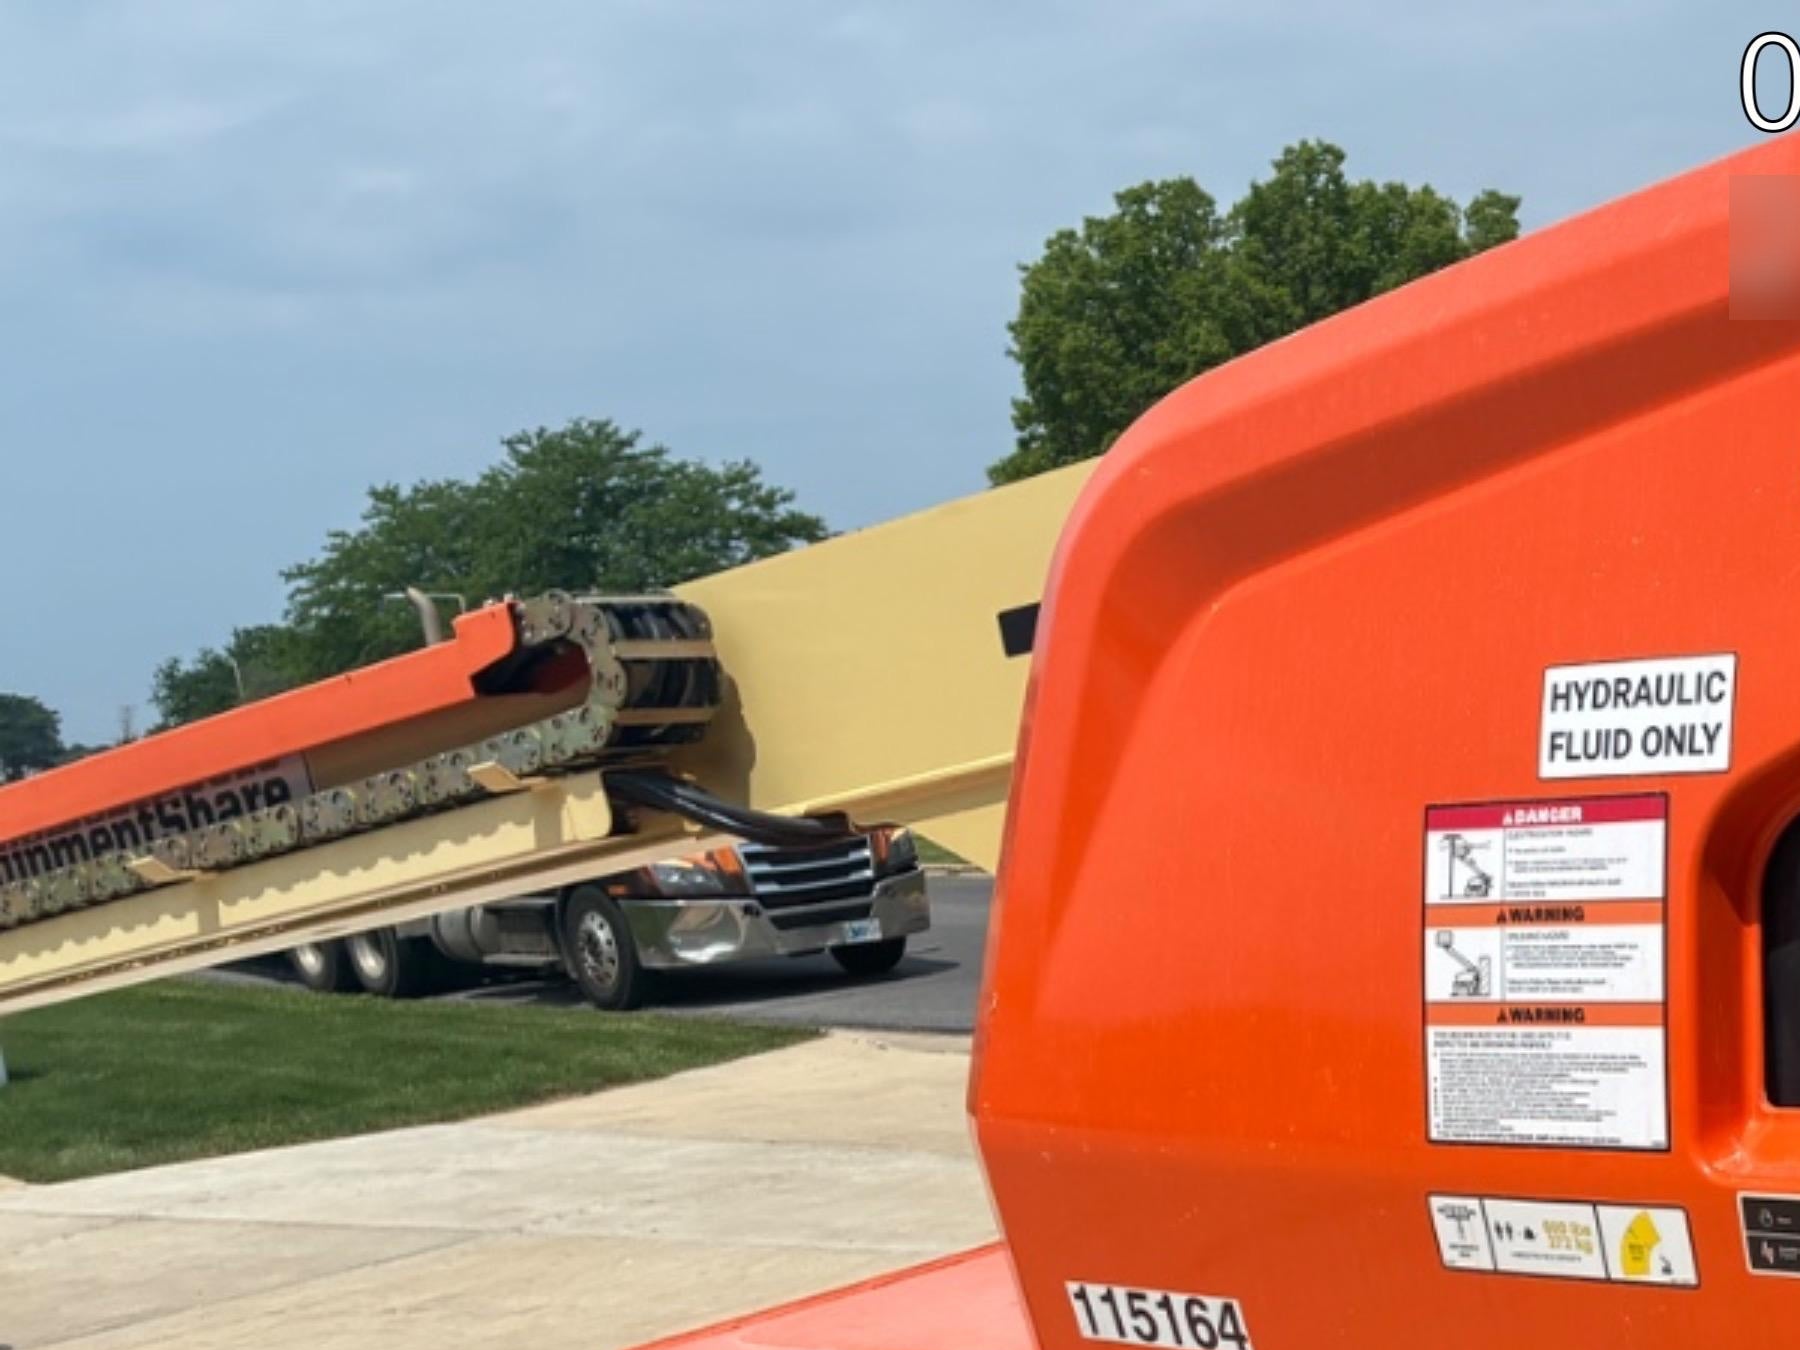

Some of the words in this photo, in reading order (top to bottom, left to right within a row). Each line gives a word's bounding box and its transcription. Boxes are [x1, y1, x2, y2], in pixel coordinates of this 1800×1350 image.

[1550, 670, 1727, 713] HYDRAULIC
[1548, 728, 1632, 762] FLUID
[1641, 722, 1722, 758] ONLY
[1515, 806, 1582, 824] DANGER
[1509, 905, 1585, 923] WARNING
[1509, 1007, 1585, 1023] WARNING
